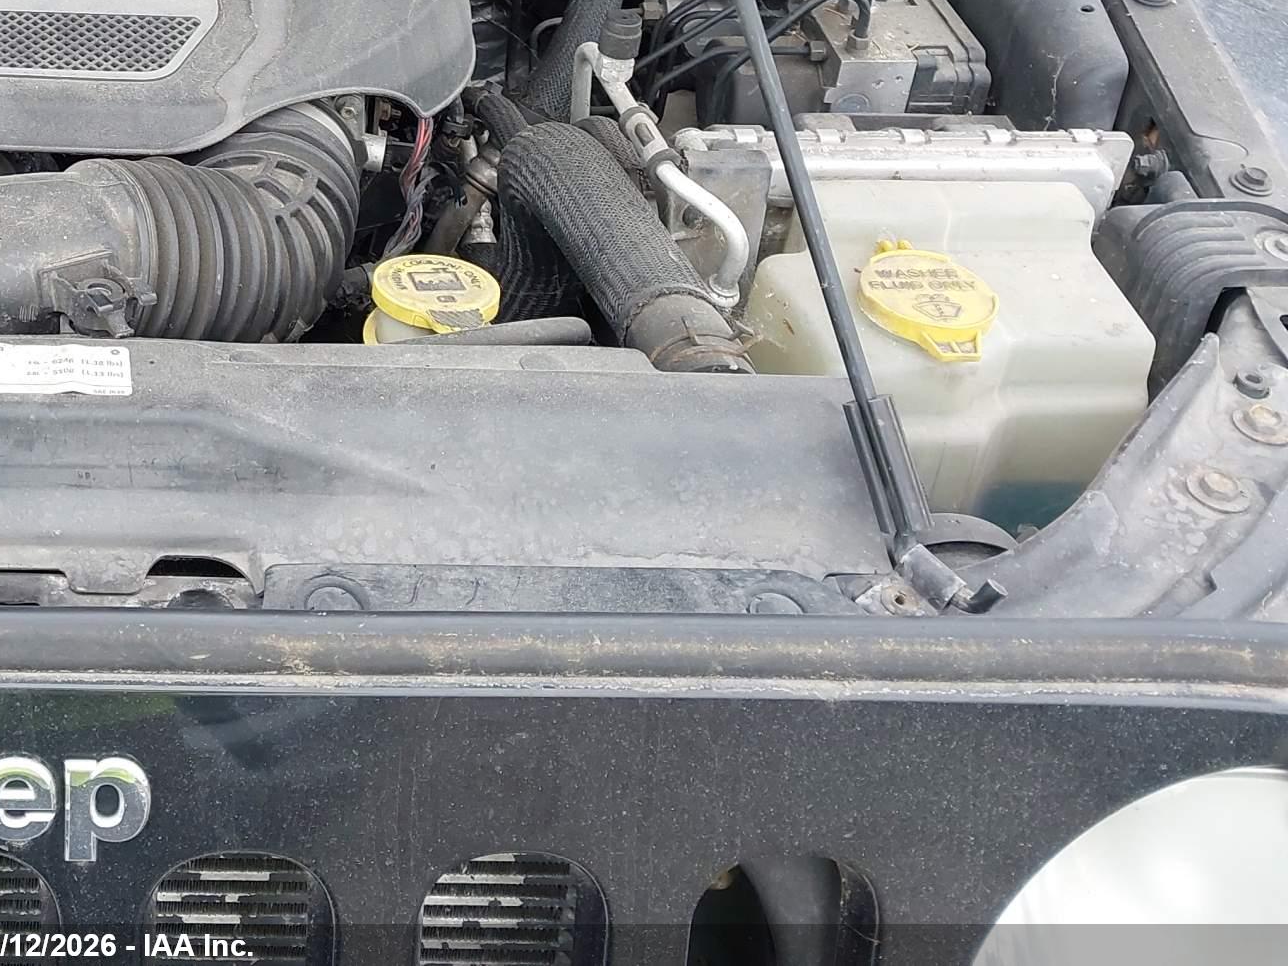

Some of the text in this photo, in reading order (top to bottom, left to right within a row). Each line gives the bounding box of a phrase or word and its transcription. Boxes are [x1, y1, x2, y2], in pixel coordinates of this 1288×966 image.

[873, 268, 959, 280] WASHER
[868, 281, 977, 291] FLUID ONLY
